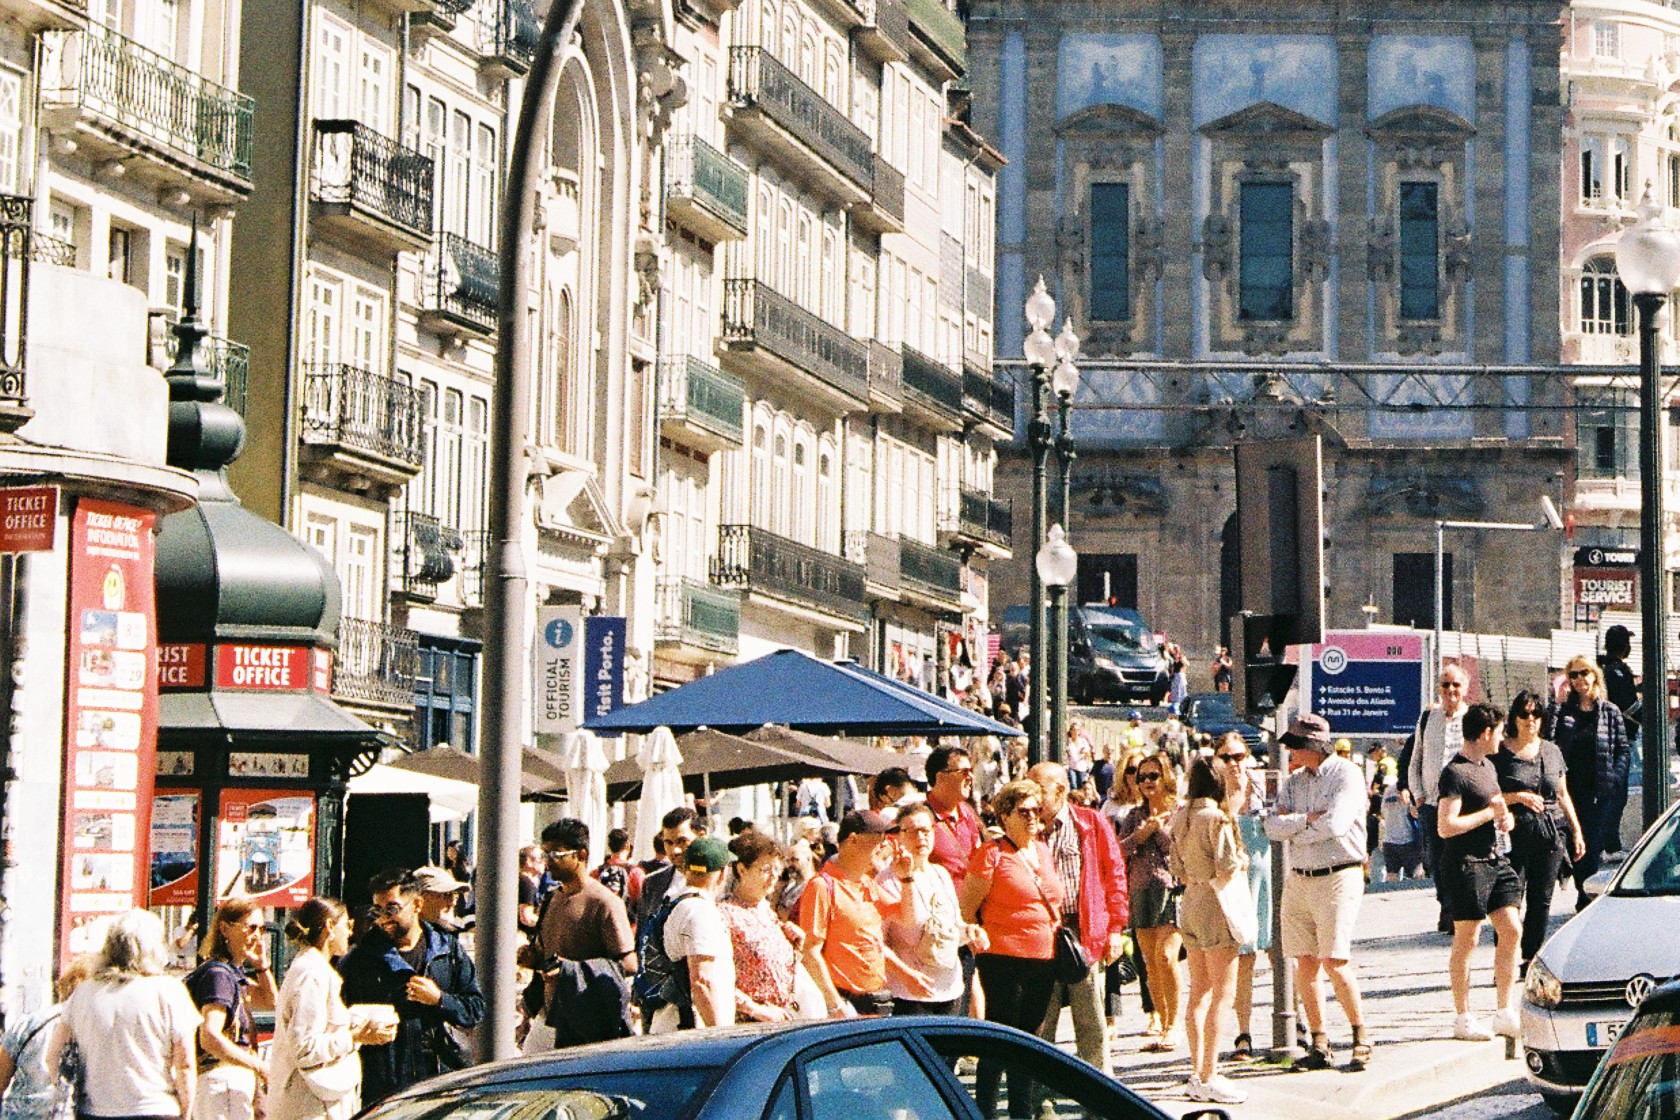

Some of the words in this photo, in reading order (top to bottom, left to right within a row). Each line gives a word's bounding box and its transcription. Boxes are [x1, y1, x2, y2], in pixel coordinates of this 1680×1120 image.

[7, 496, 47, 511] TICKET
[5, 514, 46, 529] OFFICE
[1604, 553, 1636, 563] TOURS
[1580, 579, 1633, 592] TOURIST
[1580, 591, 1633, 604] SERVICE
[156, 646, 190, 664] RIST
[233, 646, 290, 667] TICKET
[598, 630, 614, 681] Porto.
[232, 666, 290, 686] OFFICE
[546, 658, 558, 720] OFFICIAL
[559, 658, 570, 719] TOURISM
[1327, 697, 1355, 705] Avenida
[1356, 697, 1369, 705] dos
[1327, 708, 1341, 716] Rua
[1352, 708, 1361, 716] de
